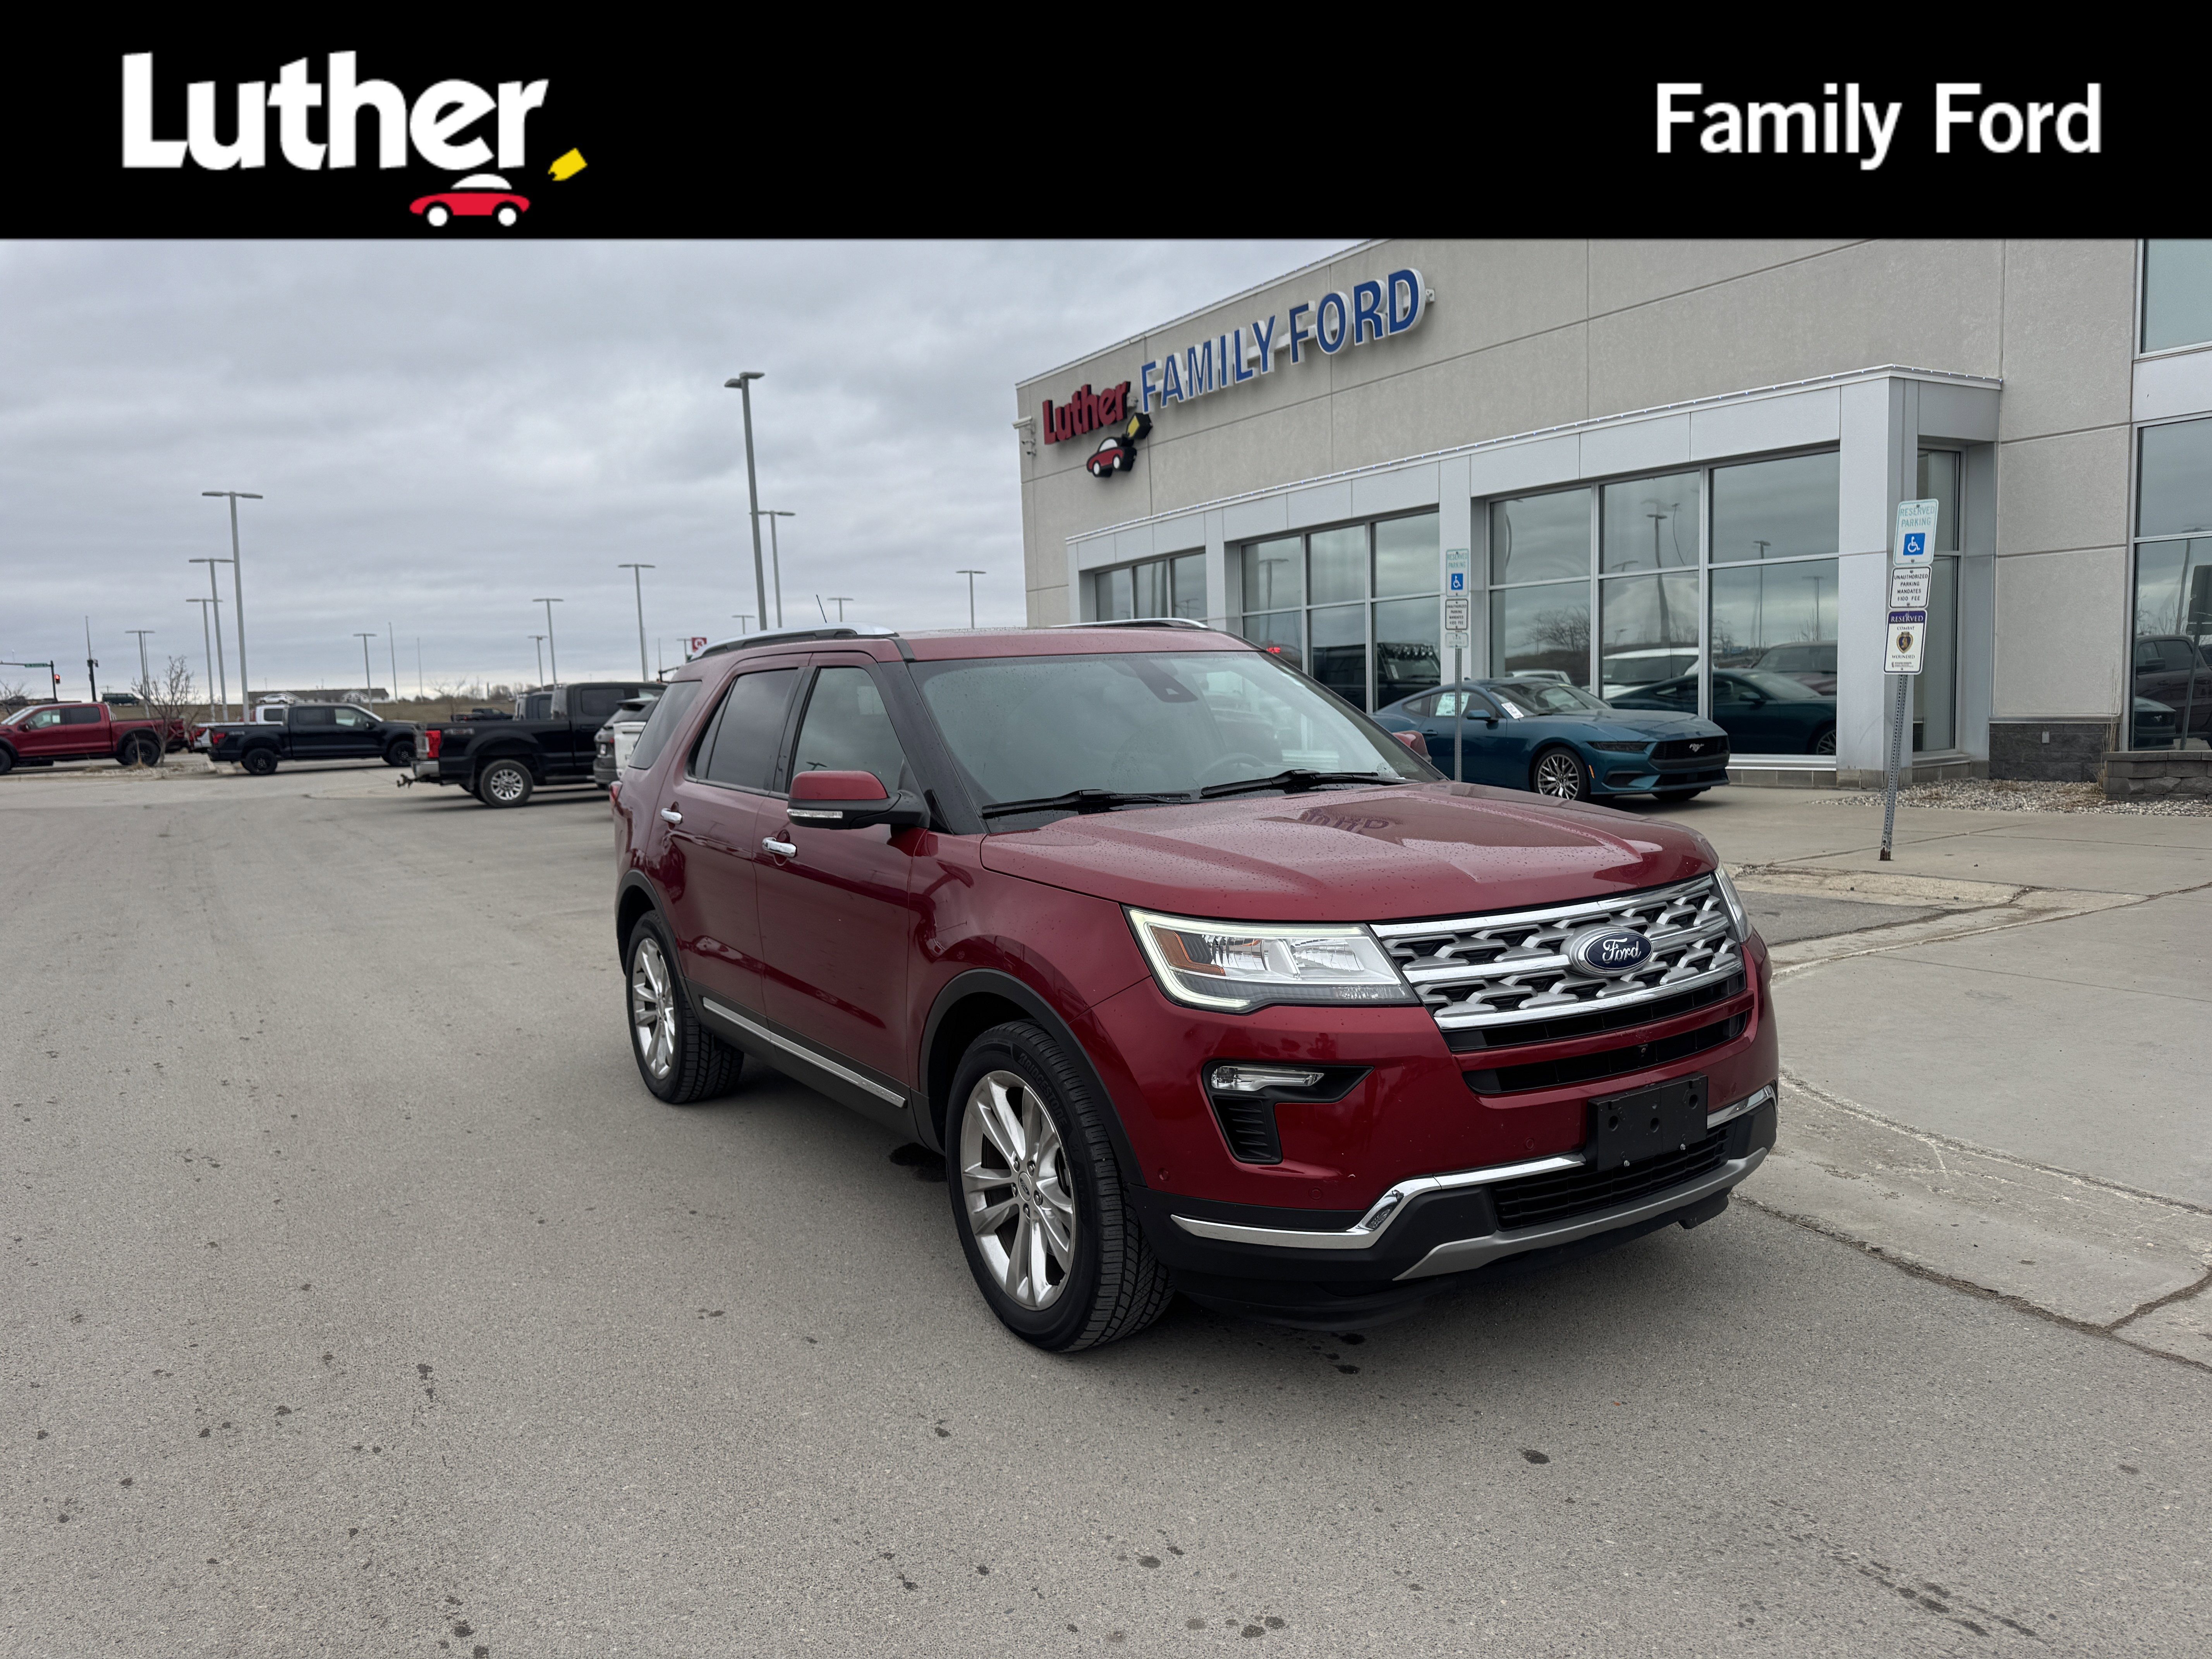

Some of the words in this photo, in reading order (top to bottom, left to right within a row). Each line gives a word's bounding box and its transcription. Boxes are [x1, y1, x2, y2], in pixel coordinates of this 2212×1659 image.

[1140, 314, 1277, 413] FAMILY
[1289, 268, 1424, 364] FORD
[1042, 381, 1131, 445] Luther
[1900, 506, 1935, 517] RESERVED
[1901, 517, 1931, 527] PARKING
[1602, 938, 1641, 963] Ford
[1018, 1053, 1067, 1126] BRIDGESTONE
